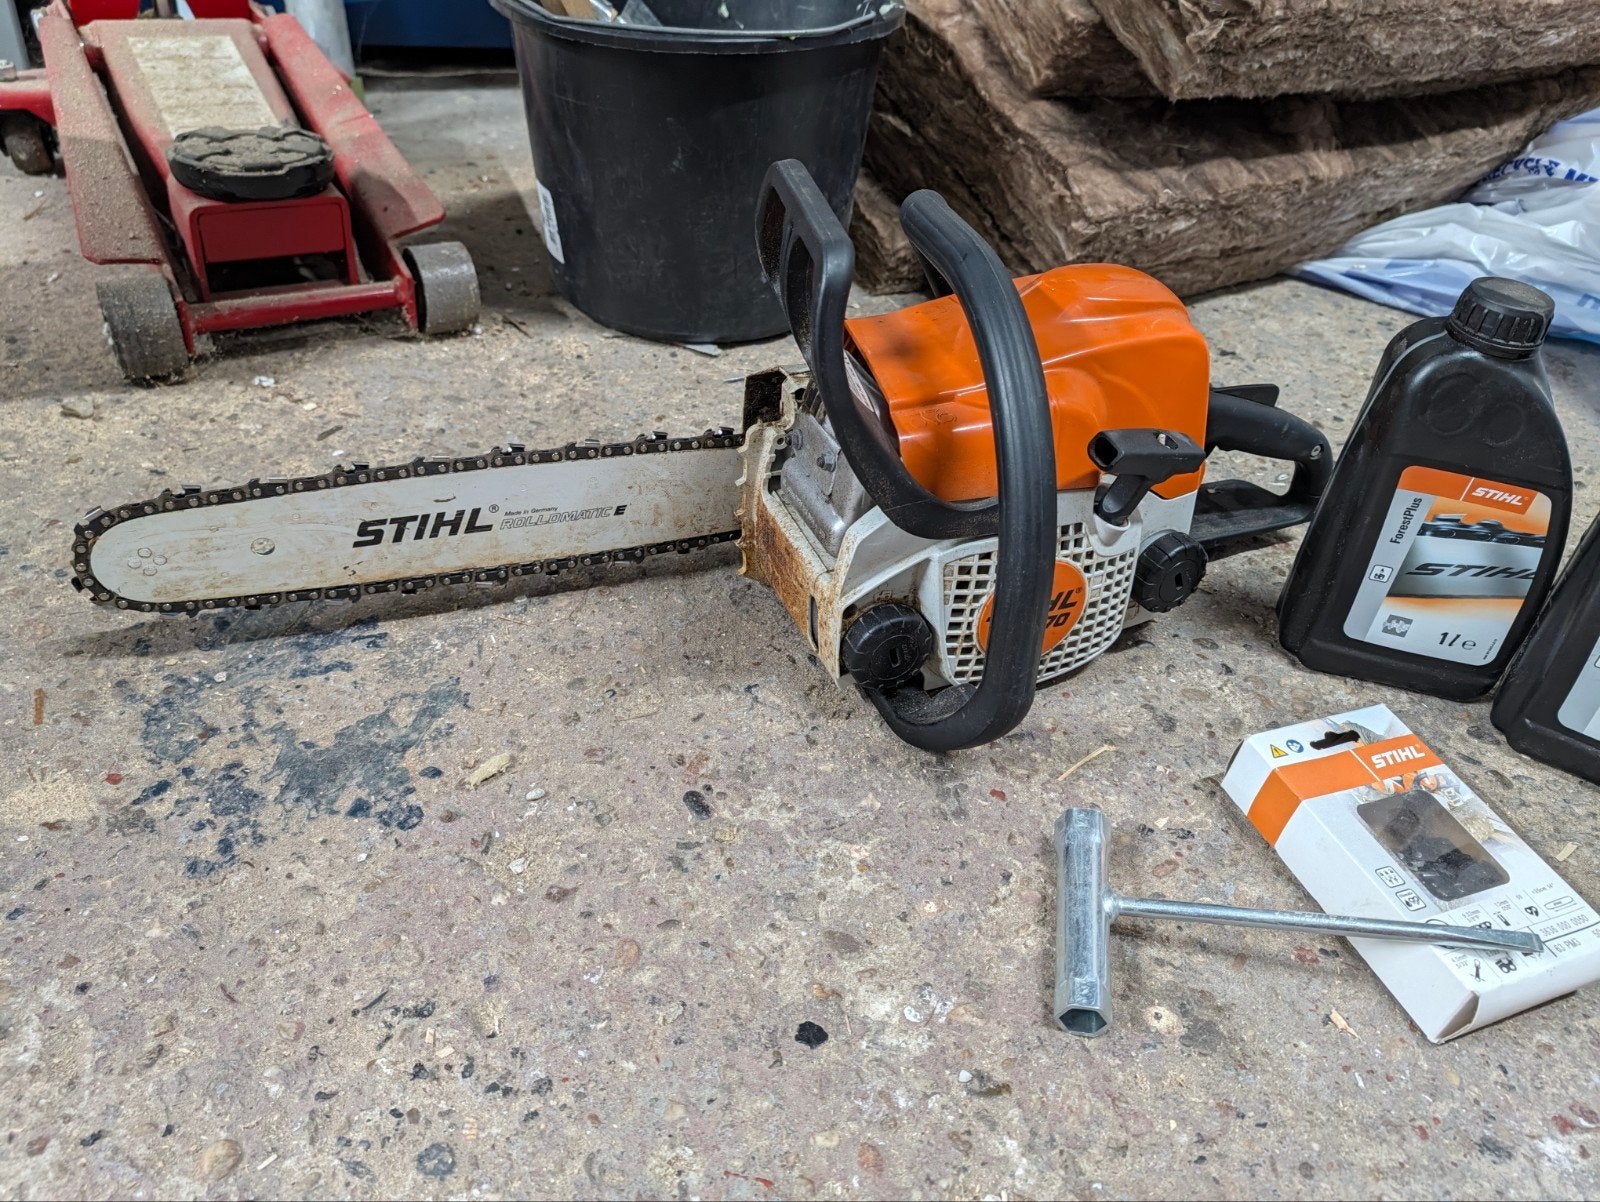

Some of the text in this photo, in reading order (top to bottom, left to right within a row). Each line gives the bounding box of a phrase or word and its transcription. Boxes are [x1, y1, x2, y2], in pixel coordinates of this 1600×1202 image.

[500, 504, 627, 530] ROLLOMATIC E
[531, 506, 559, 514] Germany
[1390, 497, 1422, 544] ForestPlus
